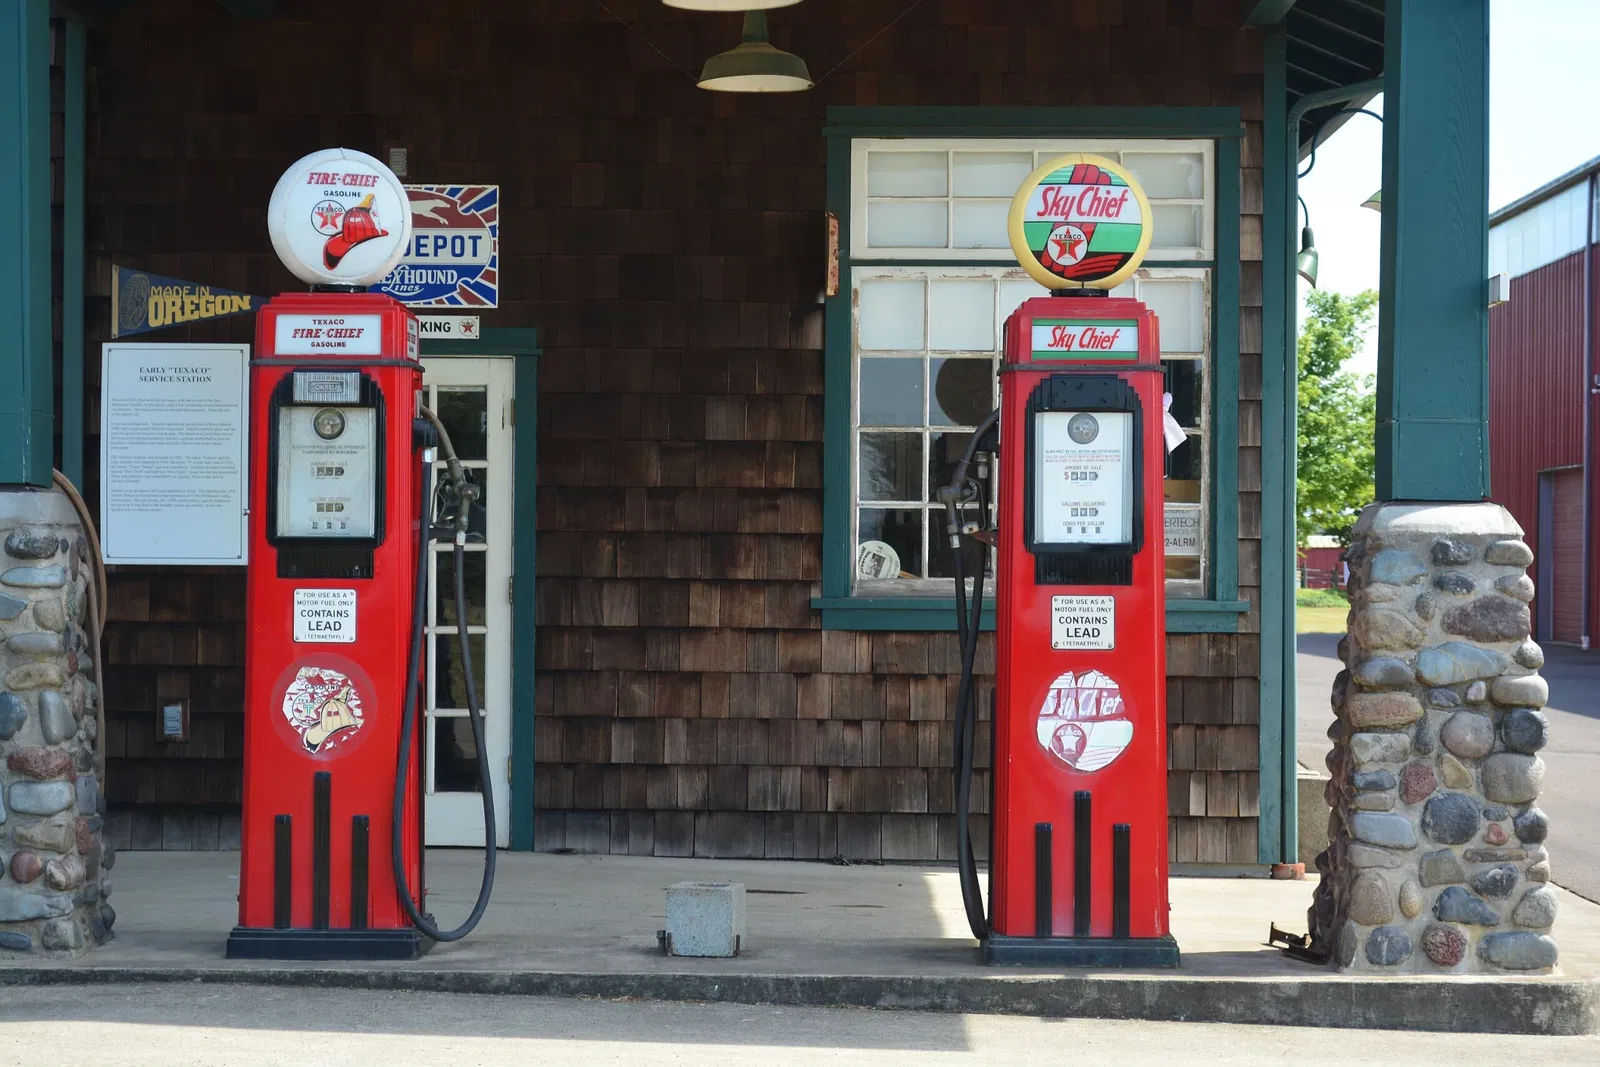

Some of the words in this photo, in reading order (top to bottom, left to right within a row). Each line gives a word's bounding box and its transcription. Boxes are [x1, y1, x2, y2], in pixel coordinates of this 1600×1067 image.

[306, 172, 379, 187] FIRE-CHIEF
[323, 190, 362, 198] GASOLINE
[1036, 186, 1077, 220] Sky
[1076, 186, 1129, 218] Chief
[376, 268, 458, 285] EYHOUND
[381, 265, 425, 296] Lines
[150, 286, 191, 297] MADE
[195, 286, 210, 297] IN
[148, 295, 252, 328] OREGON
[292, 328, 364, 339] FIRE-CHIEF
[1047, 325, 1077, 351] Sky
[1078, 327, 1121, 350] Chief
[168, 366, 212, 374] "TEXACO"
[300, 609, 349, 618] CONTAINS
[308, 620, 342, 631] LEAD
[1058, 616, 1108, 625] CONTAINS
[1066, 627, 1101, 638] LEAD
